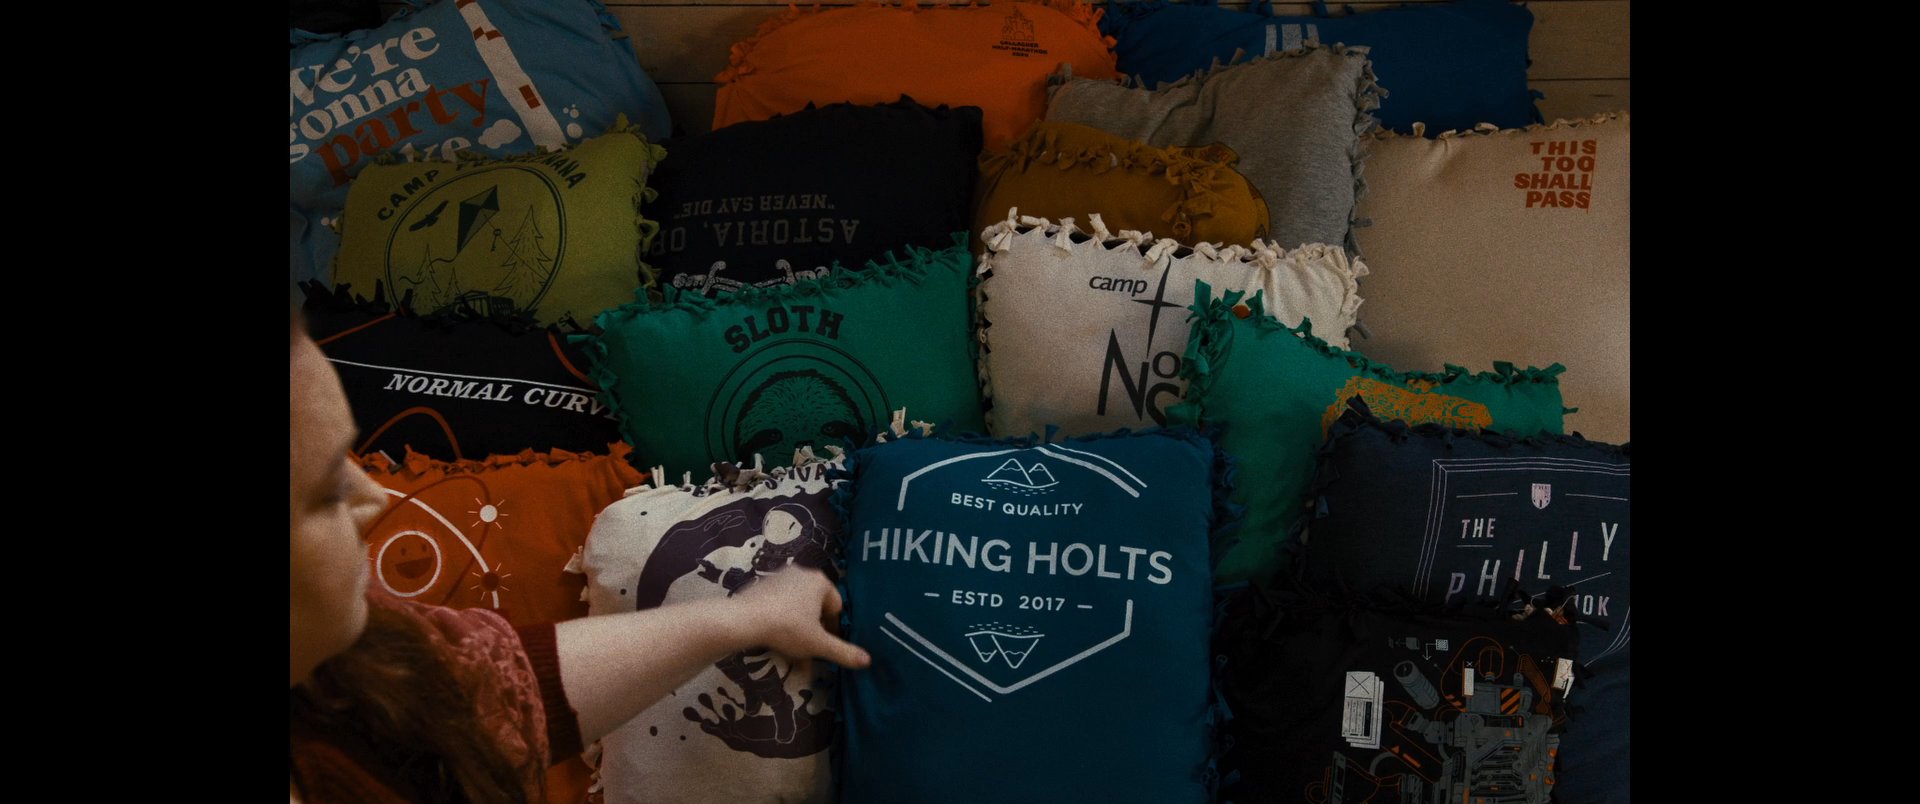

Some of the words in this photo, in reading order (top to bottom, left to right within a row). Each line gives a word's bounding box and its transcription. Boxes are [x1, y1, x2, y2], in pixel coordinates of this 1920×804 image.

[316, 78, 489, 188] party
[1530, 140, 1596, 155] THIS
[1541, 156, 1595, 172] TOO
[1514, 173, 1591, 190] SHALL
[377, 169, 439, 221] CAMP
[717, 196, 753, 213] SAY
[1526, 191, 1590, 209] PASS
[703, 218, 860, 248] ASTORIA,
[1089, 275, 1147, 296] camp
[725, 305, 844, 353] SLOTH
[384, 373, 514, 402] NORMAL
[523, 387, 619, 422] CURV
[951, 492, 996, 512] BEST
[1002, 502, 1084, 517] QUALITY
[1461, 518, 1496, 539] THE
[862, 528, 1012, 573] HIKING
[1027, 542, 1174, 585] HOLTS
[1445, 522, 1618, 604] PHILLY
[951, 590, 1003, 608] ESTD
[1019, 595, 1066, 612] 2017
